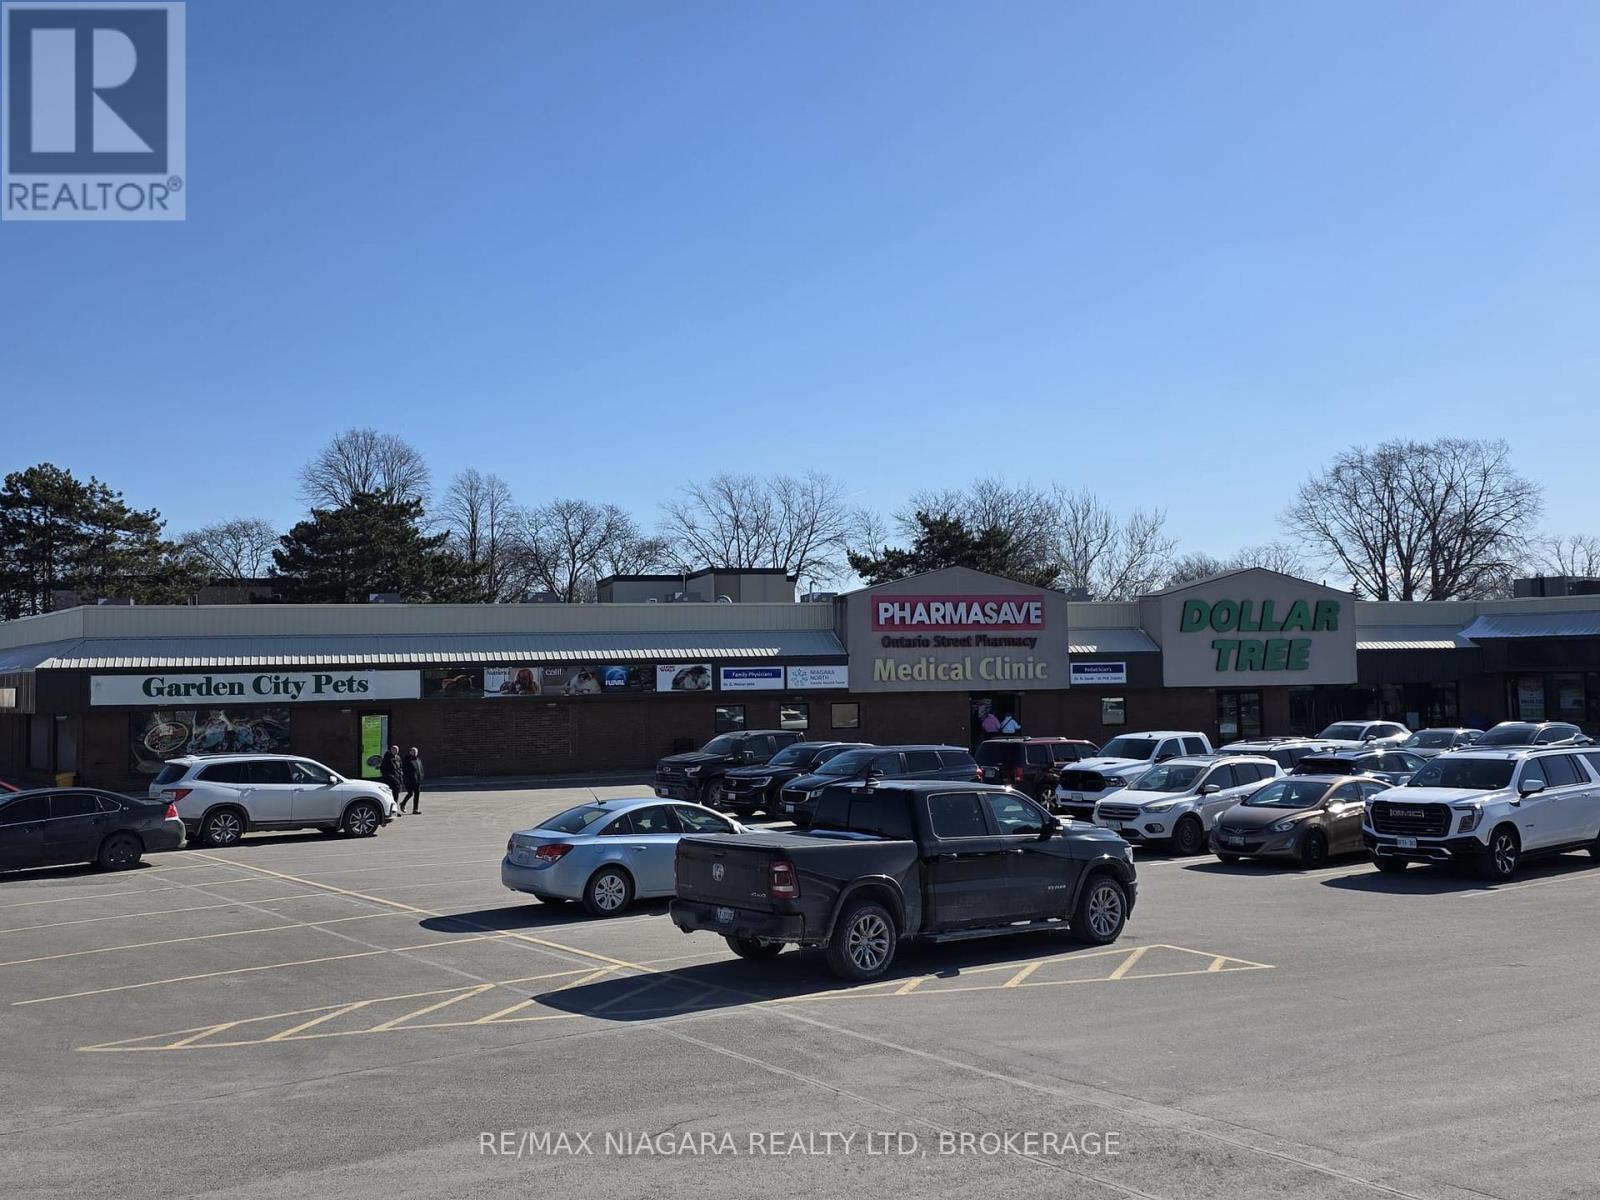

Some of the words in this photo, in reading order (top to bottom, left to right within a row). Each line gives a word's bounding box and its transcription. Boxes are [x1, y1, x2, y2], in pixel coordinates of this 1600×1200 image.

[878, 602, 1042, 625] PHARMASAVE
[1180, 599, 1341, 633] DOLLAR
[881, 635, 930, 649] Ontario
[933, 635, 972, 648] Street
[975, 634, 1038, 649] Pharmacy
[1211, 638, 1312, 672] TREE
[873, 657, 973, 681] Medical
[979, 656, 1048, 680] Clinic
[142, 676, 245, 698] Garden
[252, 674, 306, 700] City
[312, 674, 369, 694] Pets
